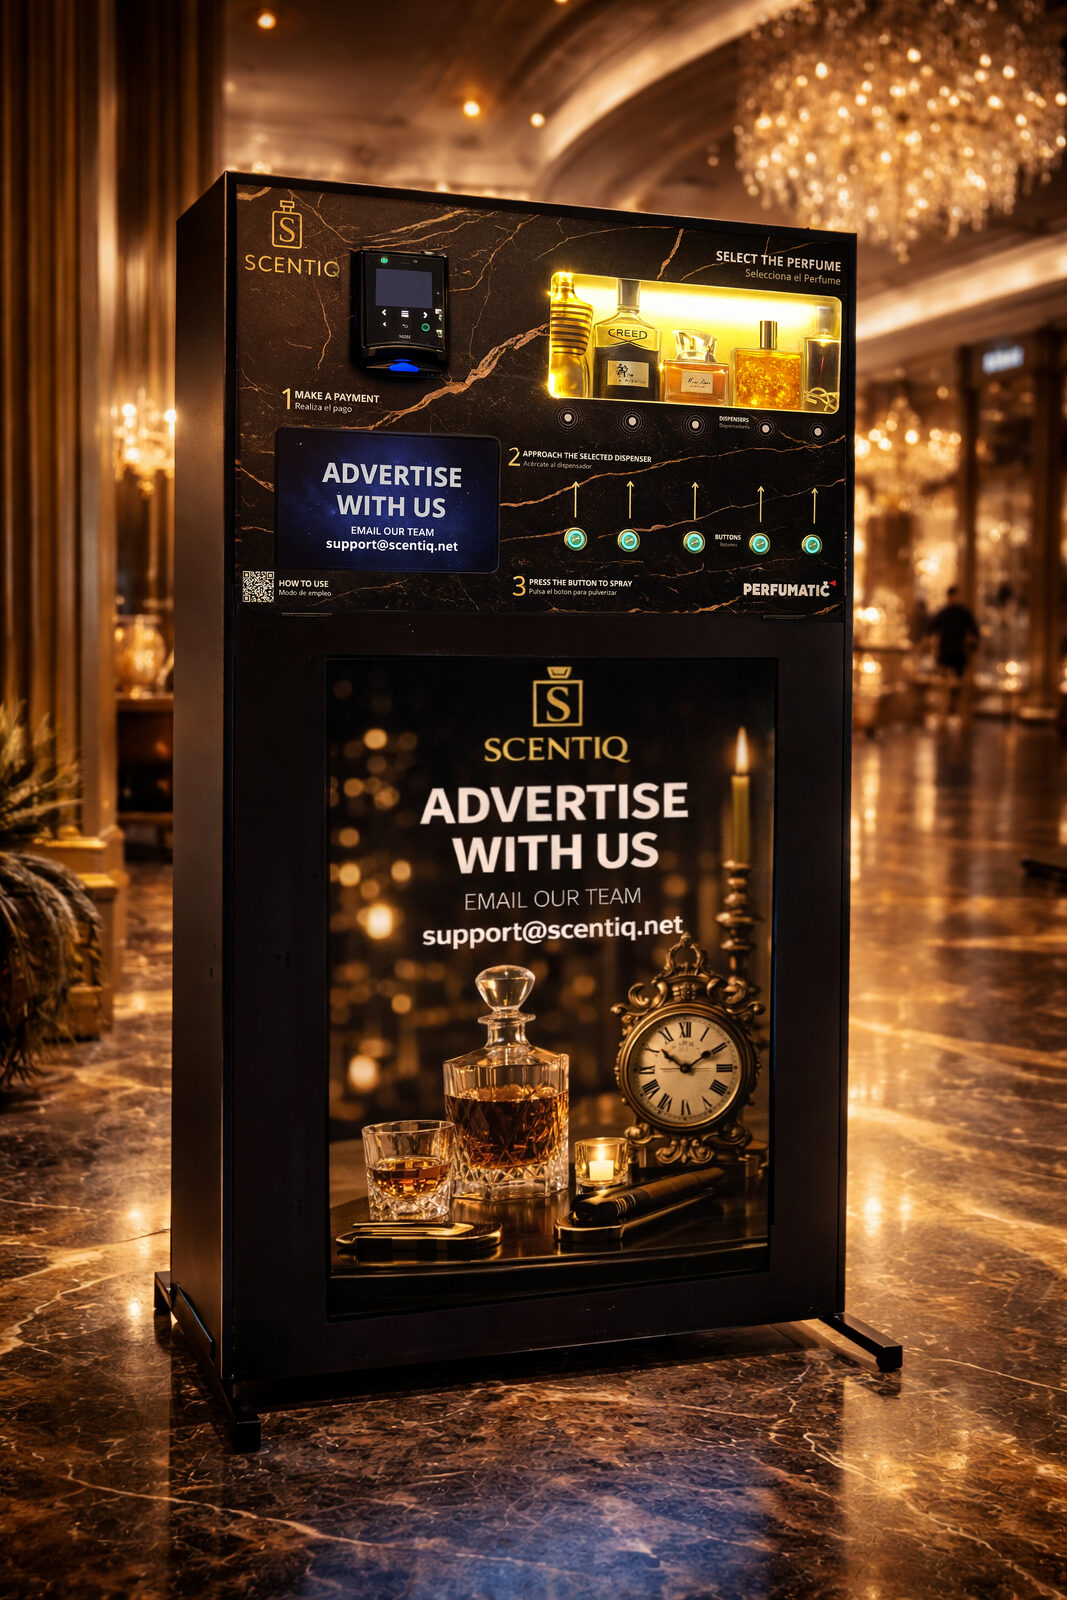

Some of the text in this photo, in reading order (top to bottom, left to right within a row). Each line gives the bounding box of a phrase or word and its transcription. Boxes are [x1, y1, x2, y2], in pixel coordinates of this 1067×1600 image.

[244, 254, 340, 278] SCENTIQ
[716, 250, 841, 272] SELECT THE PERFUME
[745, 268, 841, 285] Selecciona el Perfume
[608, 328, 648, 339] CREED
[282, 388, 380, 410] 1 MAKE A PAYMENT
[294, 402, 353, 414] Realiza el pago
[719, 415, 750, 423] DISPENSERS
[508, 447, 652, 467] 2 APPROACH THE SELECTED DISPENSER
[557, 462, 593, 470] dispensador
[322, 462, 462, 488] ADVERTISE
[336, 494, 446, 518] WITH US
[351, 526, 435, 537] EMAIL OUR TEAM
[714, 533, 742, 541] BUTTONS
[326, 539, 459, 554] support@scentiq.net
[278, 579, 329, 588] HOW TO USE
[298, 589, 307, 597] de
[308, 590, 332, 598] empleo
[512, 575, 526, 596] 3
[529, 578, 551, 586] PRESS
[568, 579, 597, 587] BUTTON
[609, 580, 633, 588] SPRAY
[588, 589, 618, 597] pulverizar
[546, 686, 571, 722] S
[484, 736, 631, 763] SCENTIQ
[419, 782, 689, 825] ADVERTISE
[451, 831, 659, 874] WITH US
[464, 887, 642, 911] EMAIL OUR TEAM
[422, 915, 684, 950] support@scentiq.net
